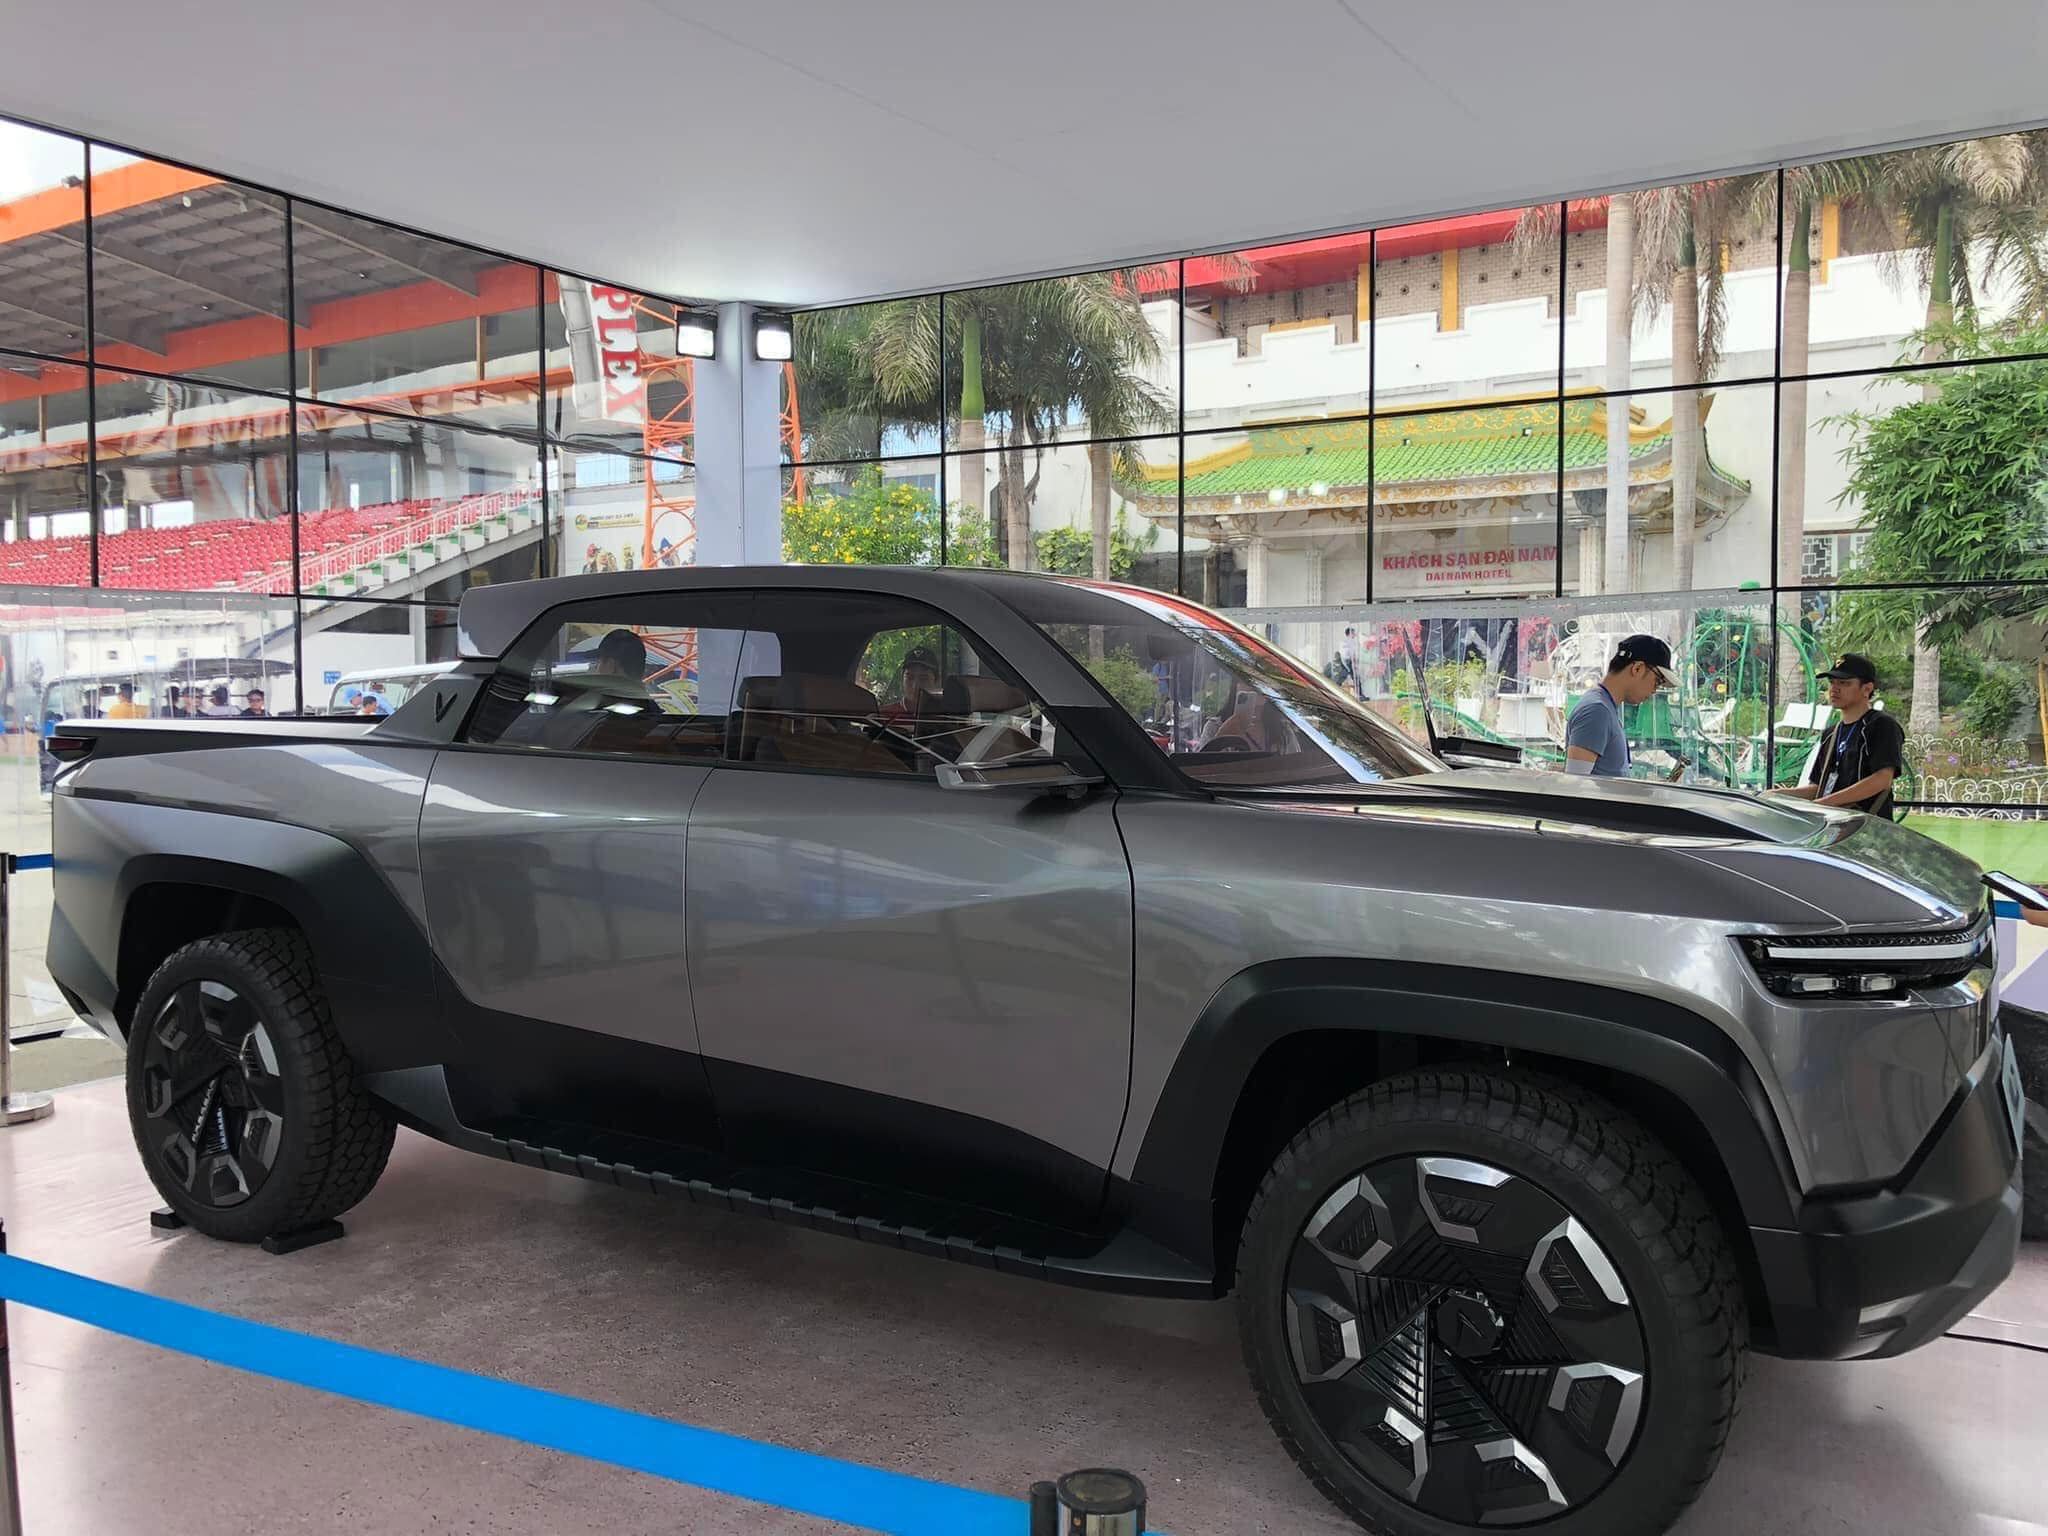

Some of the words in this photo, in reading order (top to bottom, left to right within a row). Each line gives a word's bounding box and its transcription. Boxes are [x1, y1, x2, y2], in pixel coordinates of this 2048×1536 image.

[591, 285, 647, 416] PLEX
[1383, 552, 1442, 570] KHÁCH
[1446, 552, 1480, 570] SẠN
[1484, 550, 1514, 567] ĐẠI
[1518, 546, 1559, 562] NAM
[1446, 571, 1471, 581] NAM
[1475, 569, 1512, 580] HOTEL
